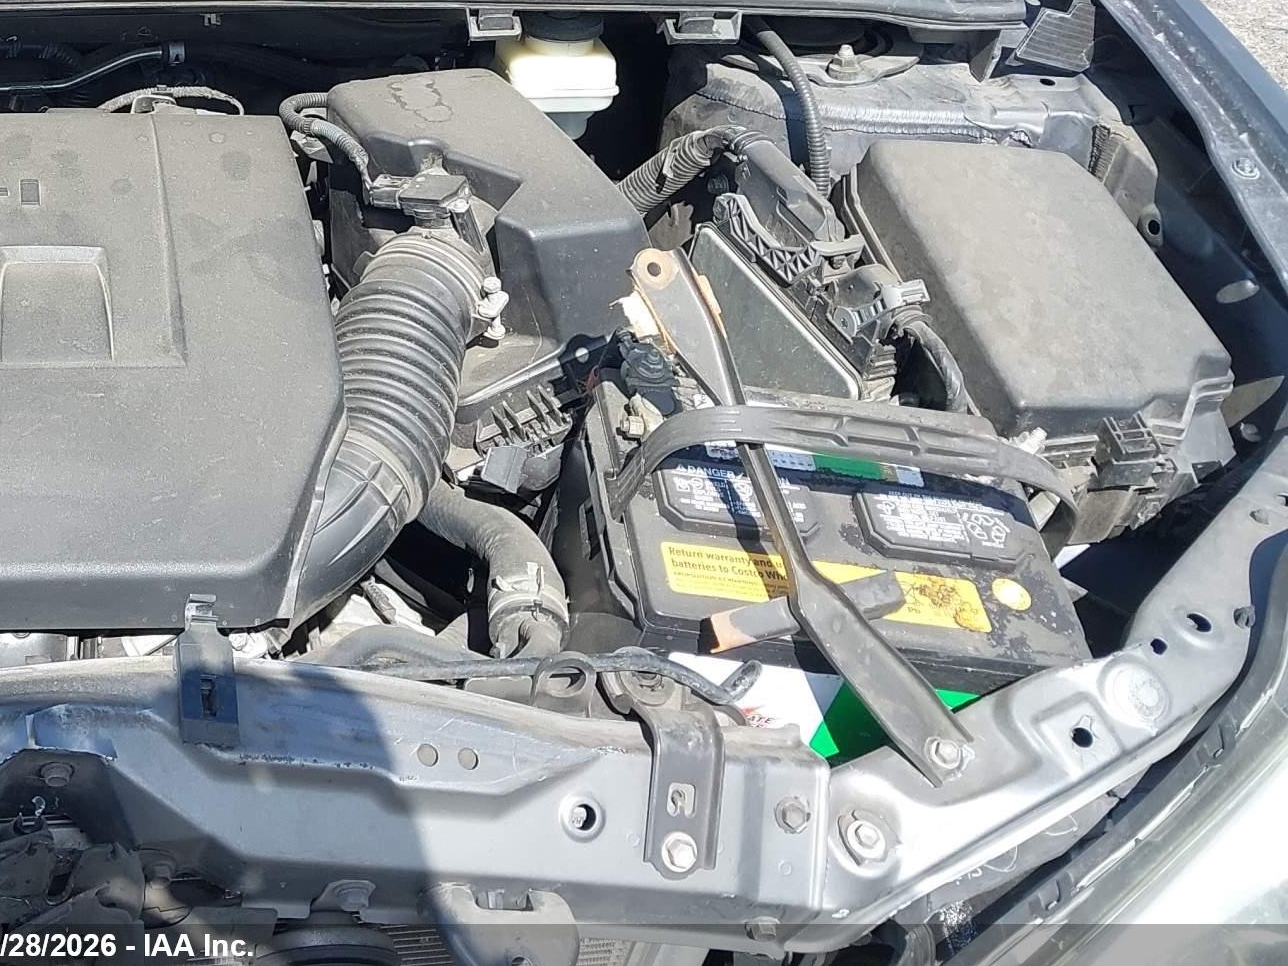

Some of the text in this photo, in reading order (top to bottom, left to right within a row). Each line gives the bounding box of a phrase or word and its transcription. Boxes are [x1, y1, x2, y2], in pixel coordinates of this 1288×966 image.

[669, 547, 703, 558] Return
[707, 553, 751, 567] warranty
[753, 558, 772, 567] and
[672, 559, 716, 572] batteries
[719, 565, 729, 574] to
[732, 566, 763, 579] Costco
